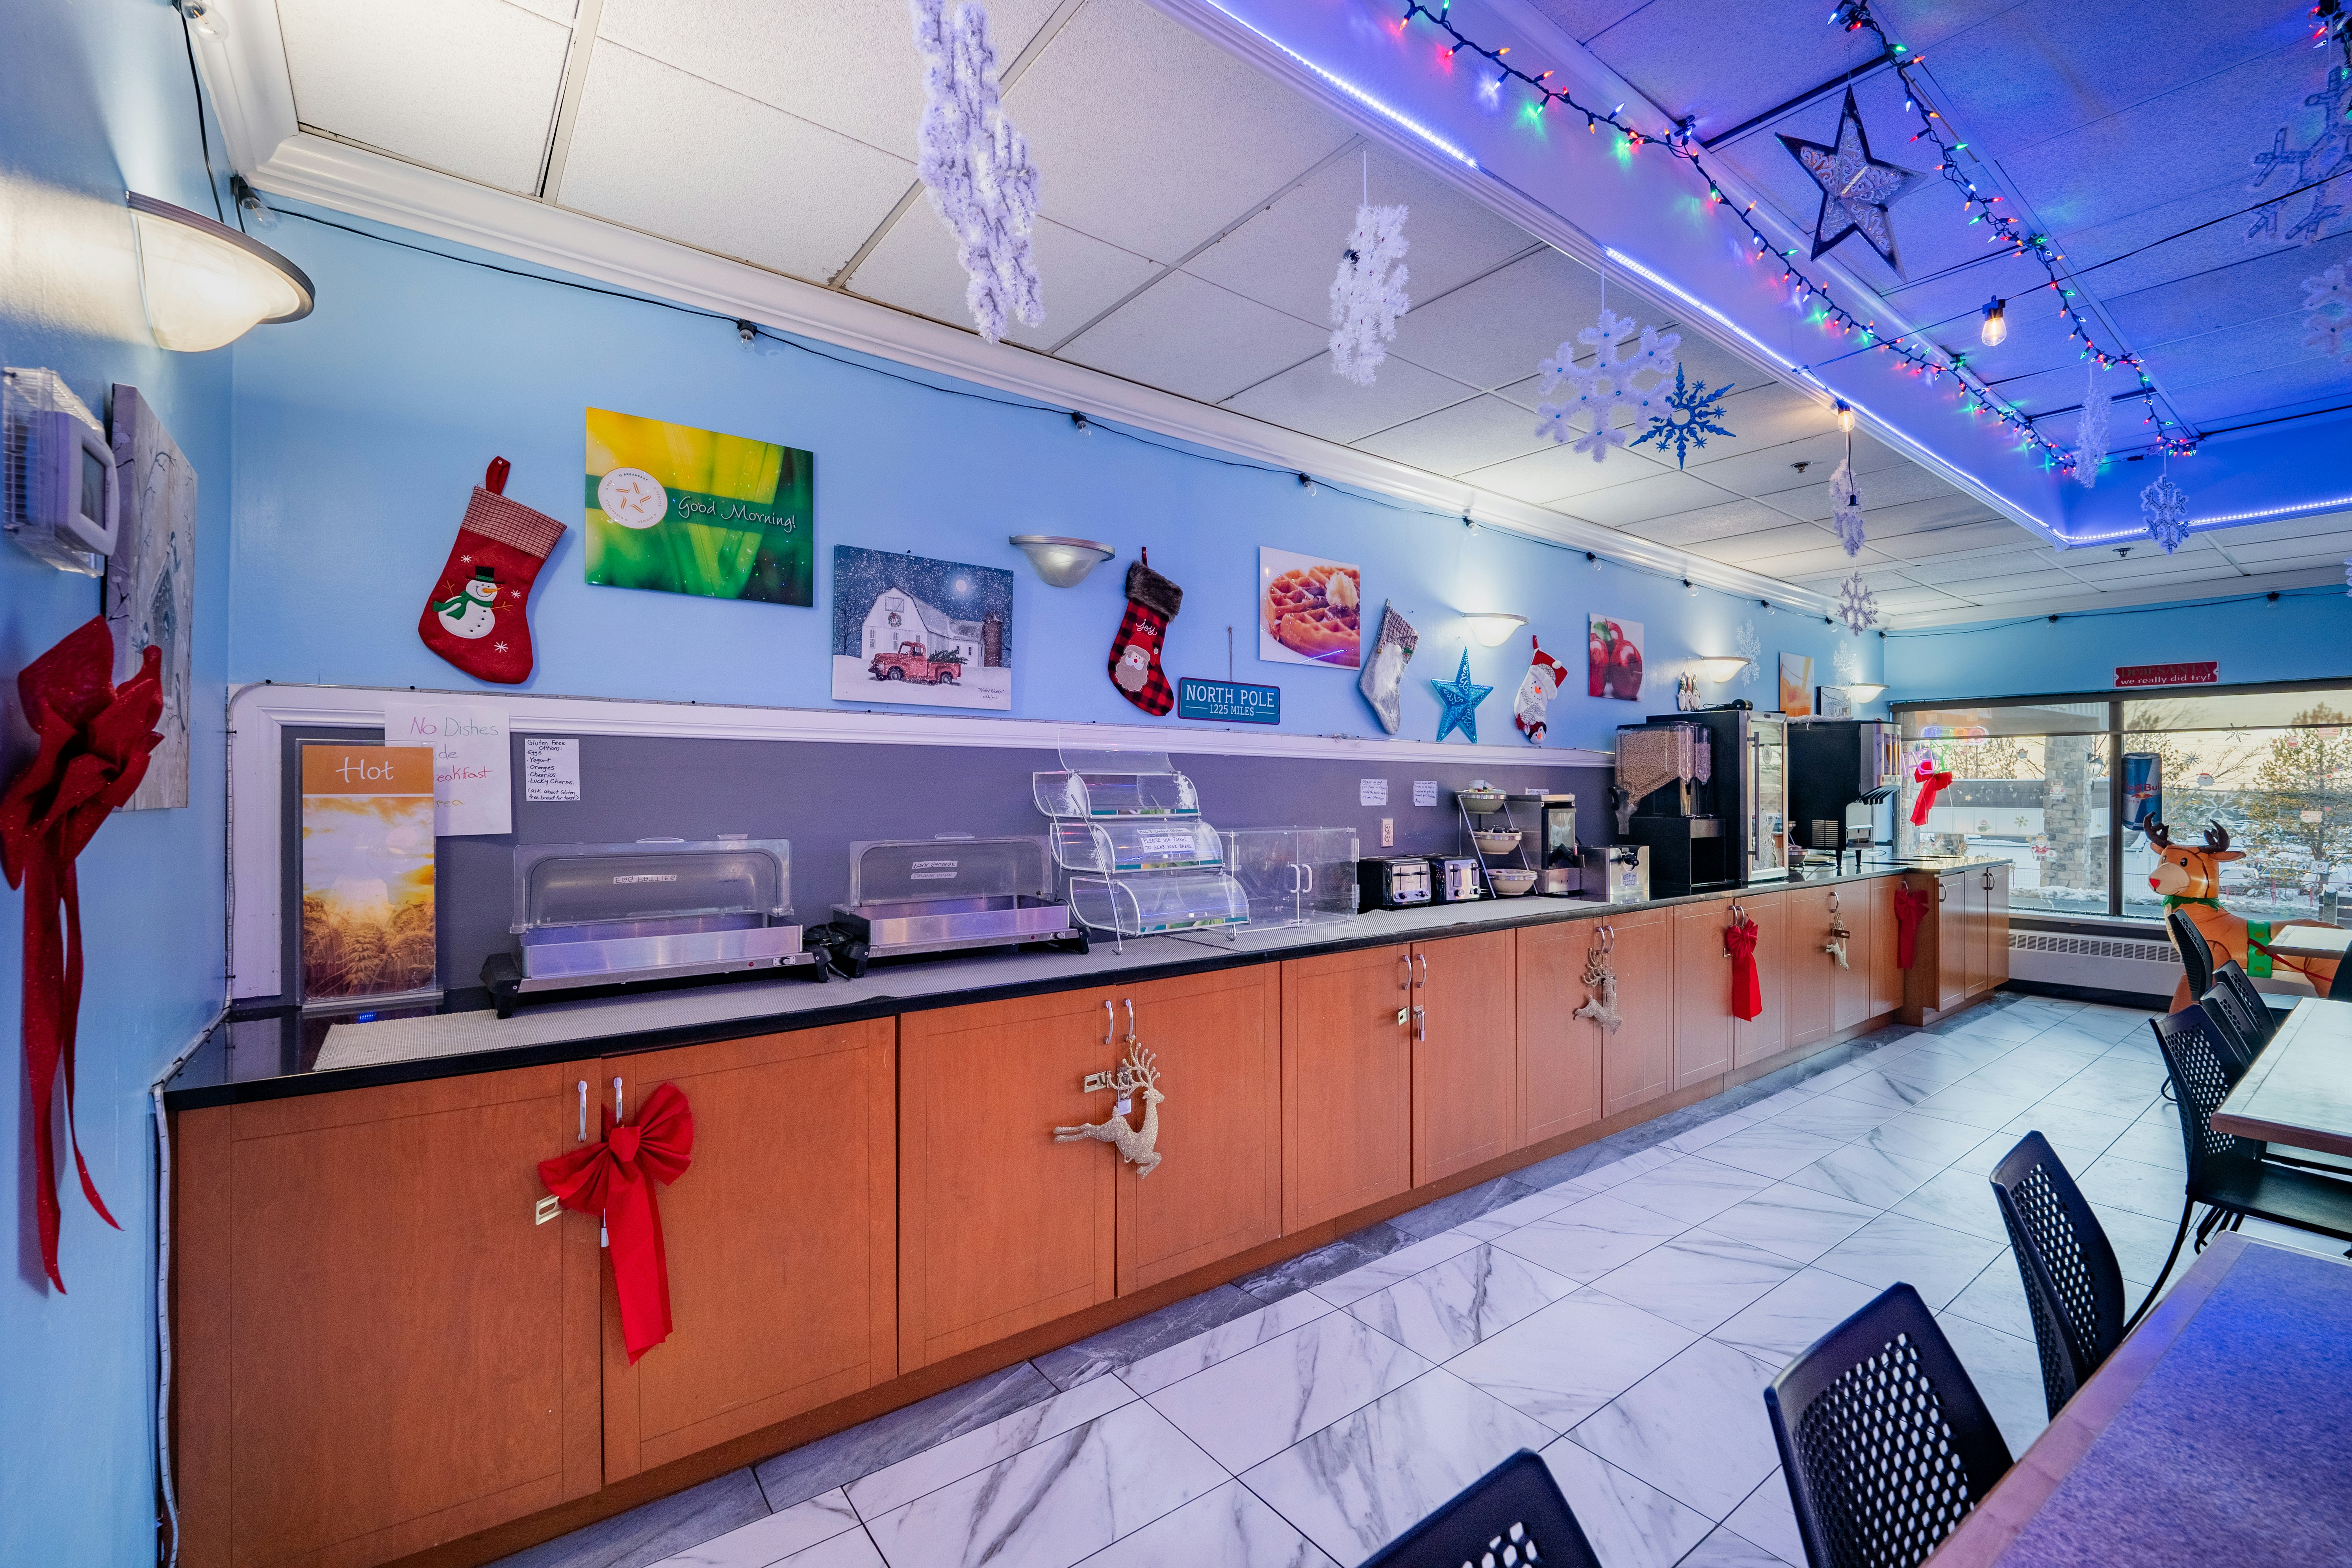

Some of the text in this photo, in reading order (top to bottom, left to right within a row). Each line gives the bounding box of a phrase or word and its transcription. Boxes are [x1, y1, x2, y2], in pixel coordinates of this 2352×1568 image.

[623, 473, 648, 481] BREAKFAST
[605, 499, 623, 520] ESSENTIALS
[678, 496, 796, 533] Good Morning!
[2121, 664, 2210, 678] Dear SANTA
[2191, 674, 2211, 682] try!
[1186, 685, 1274, 707] NORTH POLE
[1210, 704, 1254, 716] 1225 MILES
[410, 717, 499, 737] No Dishes
[336, 756, 394, 783] Hot
[434, 765, 493, 782] eakfast
[2144, 782, 2161, 791] Bull
